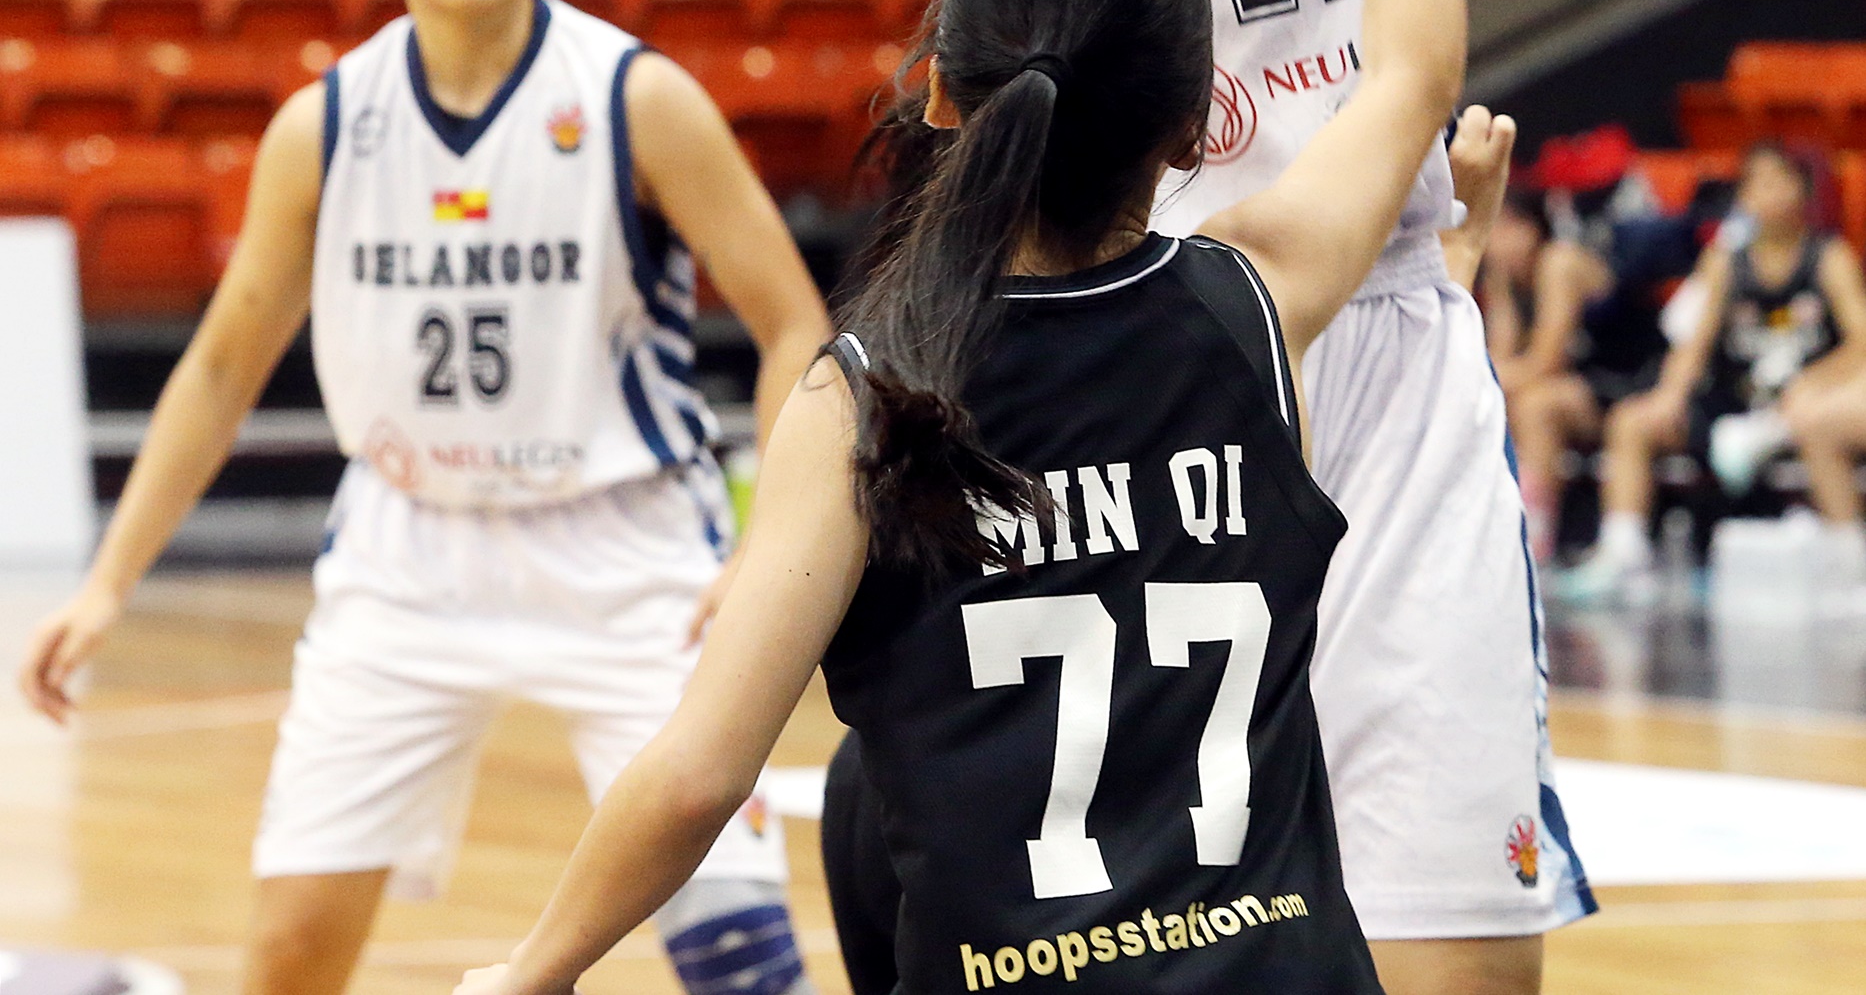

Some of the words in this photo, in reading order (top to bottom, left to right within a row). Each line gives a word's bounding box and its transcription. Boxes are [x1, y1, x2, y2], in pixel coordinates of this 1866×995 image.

[416, 305, 512, 407] 25
[962, 462, 1140, 576] MIN
[1168, 445, 1247, 545] QI
[961, 581, 1272, 900] 77
[960, 893, 1310, 992] hoopsstation.com
